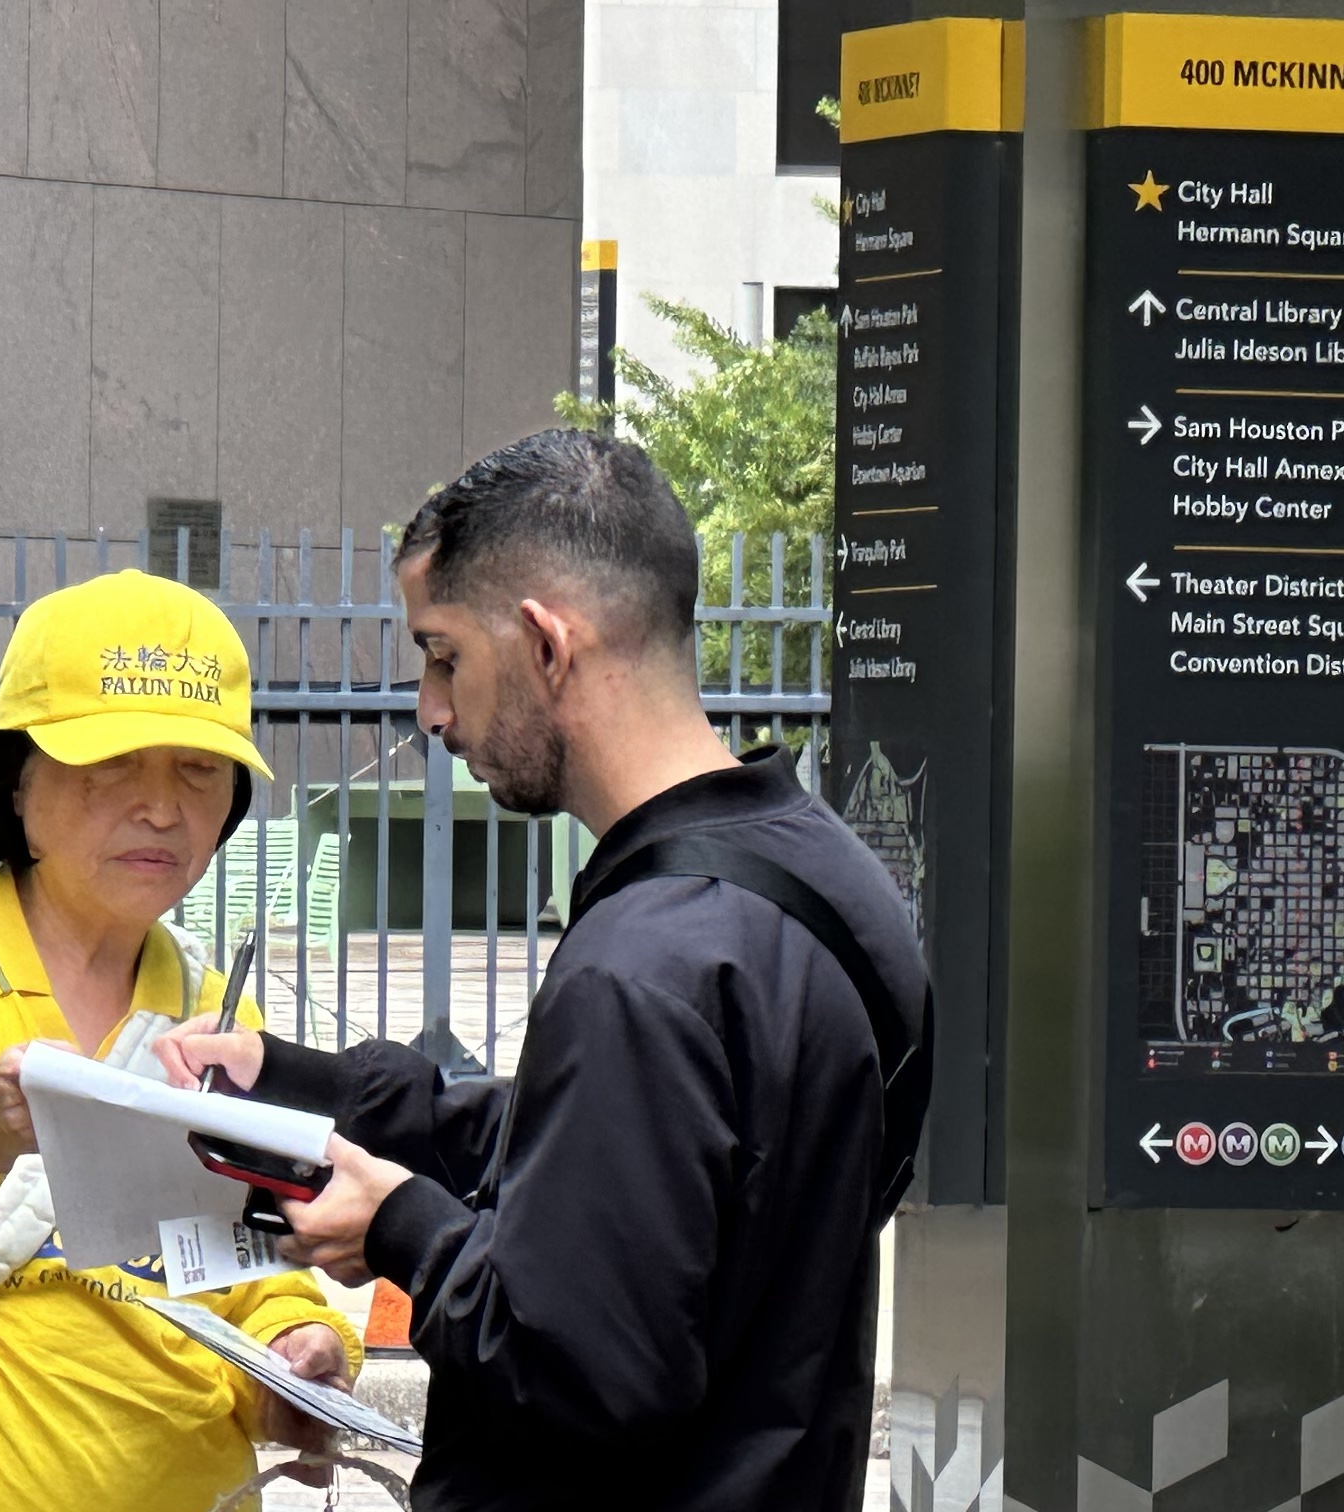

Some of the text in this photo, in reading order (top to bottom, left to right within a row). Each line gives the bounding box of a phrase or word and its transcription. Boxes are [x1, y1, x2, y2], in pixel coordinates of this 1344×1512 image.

[1180, 58, 1225, 86] 400
[1177, 180, 1273, 210] City Hall
[1177, 220, 1280, 245] Hermann
[1175, 297, 1343, 331] Central Library
[1174, 337, 1226, 360] Julia
[1233, 338, 1308, 362] Ideson
[1174, 415, 1221, 438] Sam
[1229, 417, 1324, 441] Houston
[1173, 454, 1219, 484] City
[1225, 455, 1268, 479] Hall
[1173, 493, 1332, 524] Hobby Center
[1170, 571, 1344, 598] Theater District
[1171, 611, 1226, 634] Main
[1232, 612, 1301, 636] Street
[100, 644, 222, 681] 法輪大法
[1170, 650, 1300, 675] Convention
[100, 675, 174, 695] FALUN
